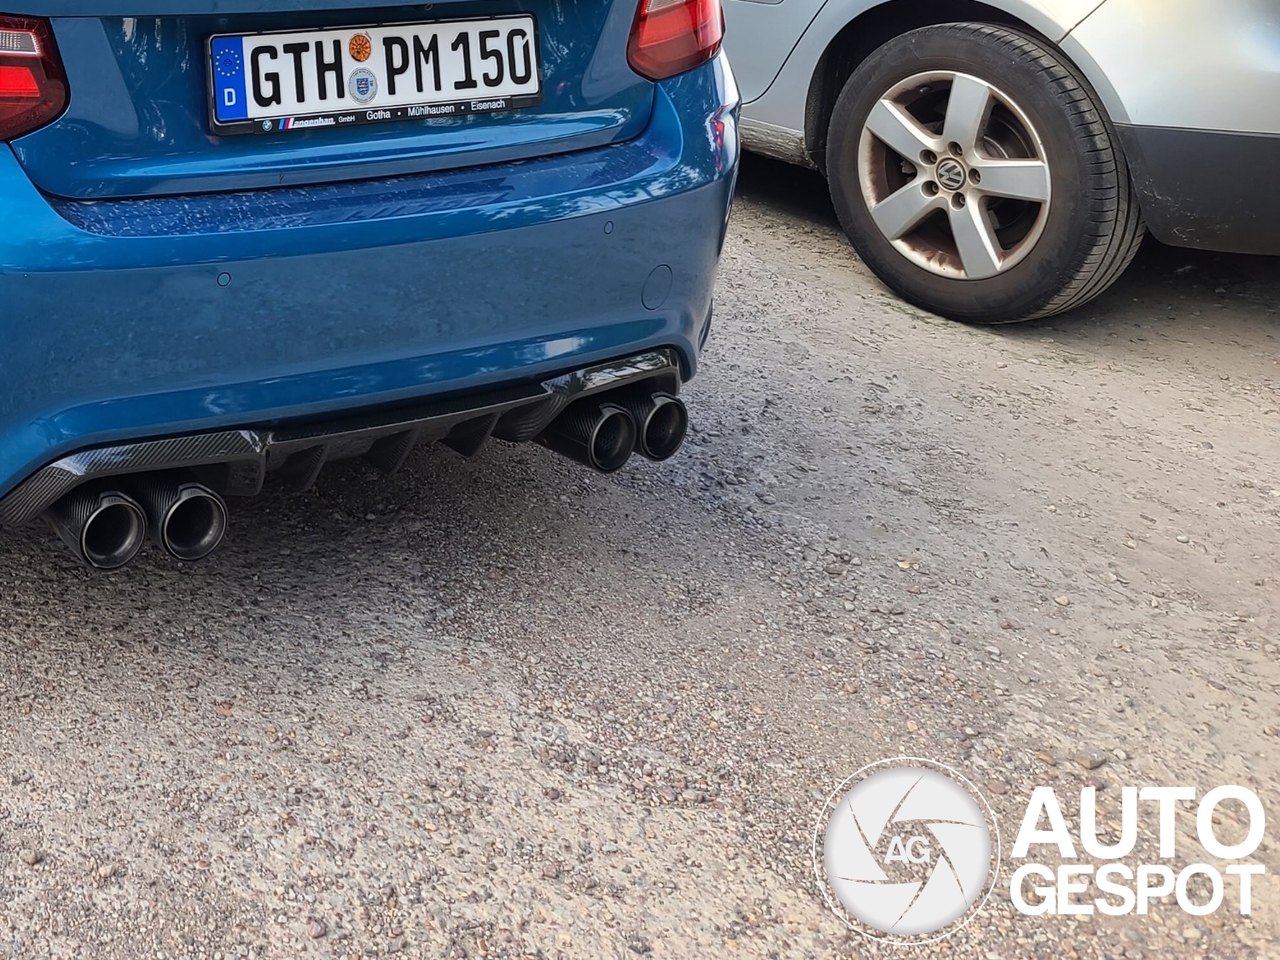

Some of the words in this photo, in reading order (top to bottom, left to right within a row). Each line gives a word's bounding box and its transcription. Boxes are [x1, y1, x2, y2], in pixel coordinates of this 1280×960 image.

[250, 39, 345, 107] GTH
[383, 33, 442, 95] PM
[451, 28, 532, 89] 150
[224, 88, 236, 106] D
[338, 115, 355, 123] GmbH
[366, 110, 391, 121] Gotha
[407, 104, 455, 117] Mühlhausen
[471, 99, 506, 111] Eisenach
